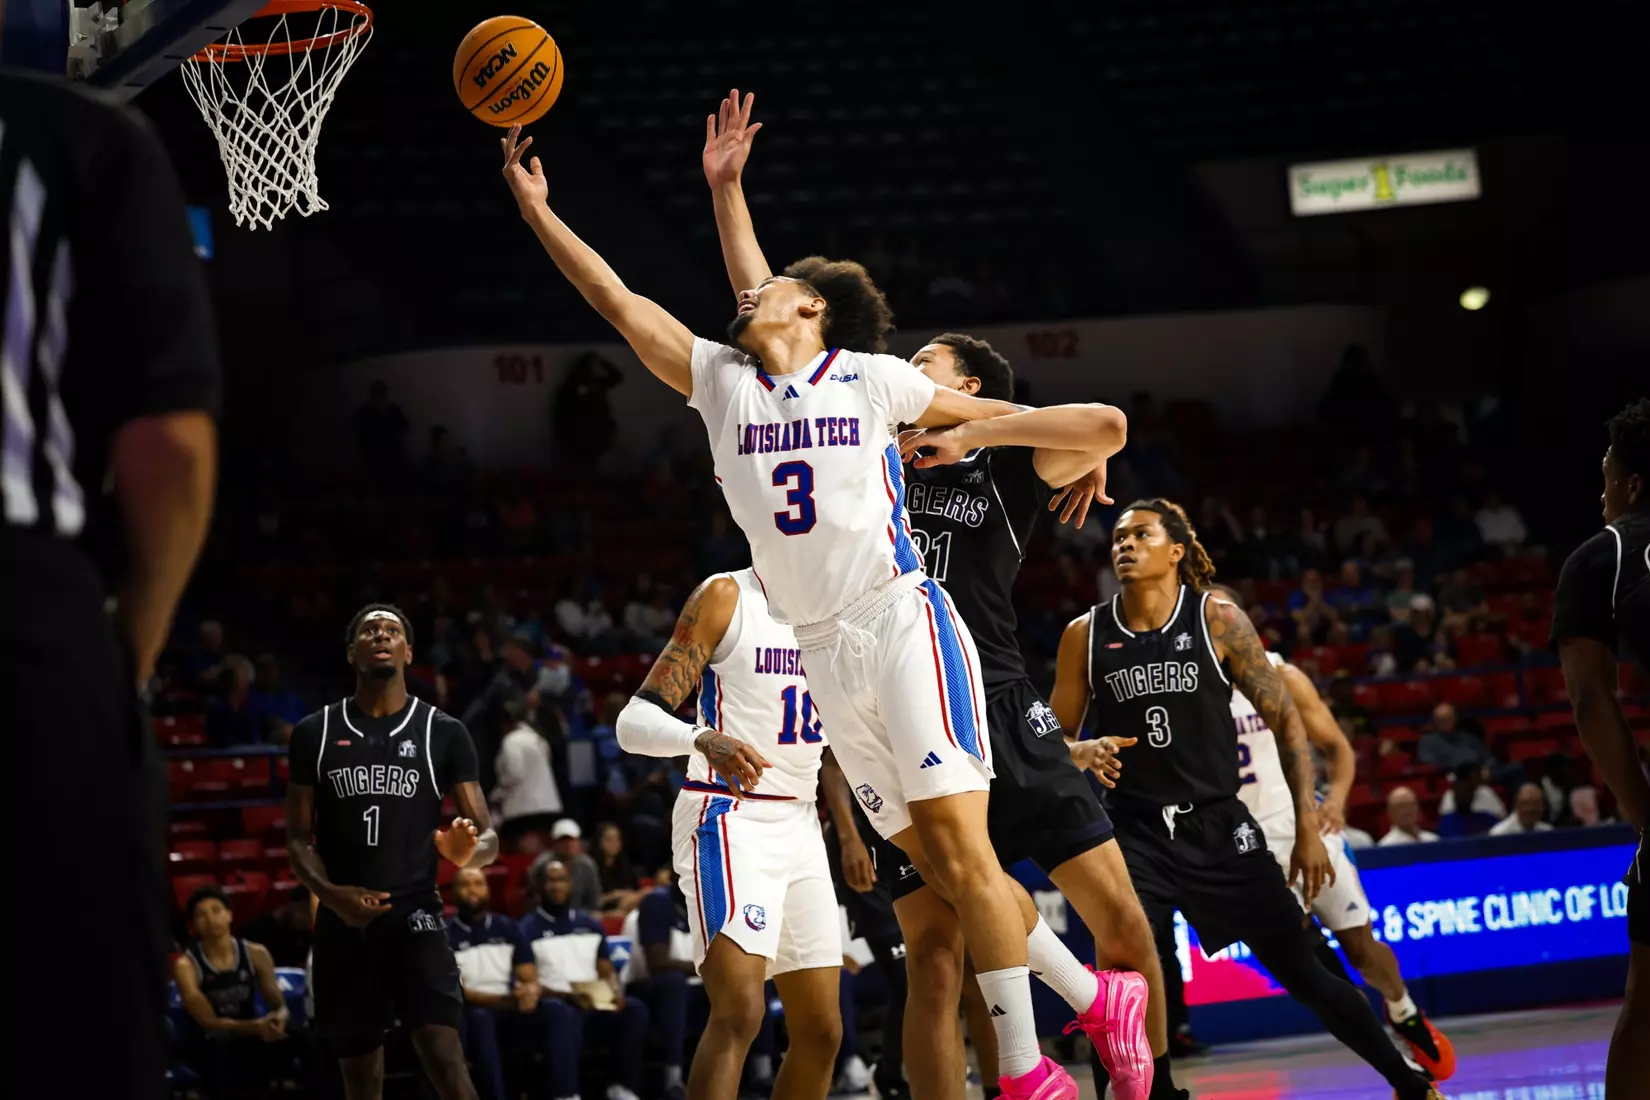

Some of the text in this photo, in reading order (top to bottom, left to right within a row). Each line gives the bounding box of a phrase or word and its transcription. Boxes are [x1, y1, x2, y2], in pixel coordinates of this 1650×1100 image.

[474, 42, 518, 88] NCAA
[488, 61, 551, 114] Wilson
[1025, 329, 1080, 358] 102
[494, 355, 545, 385] 101
[737, 417, 861, 456] LOUISIANA TECH
[772, 460, 817, 536] 3
[906, 482, 990, 528] GERS
[1104, 661, 1199, 703] TIGERS
[1145, 706, 1172, 748] 3
[327, 764, 420, 799] TIGERS
[363, 805, 380, 846] 1
[1383, 904, 1403, 943] &
[1405, 896, 1482, 941] SPINE
[1483, 887, 1564, 931] CLINIC
[1564, 884, 1597, 922] OF
